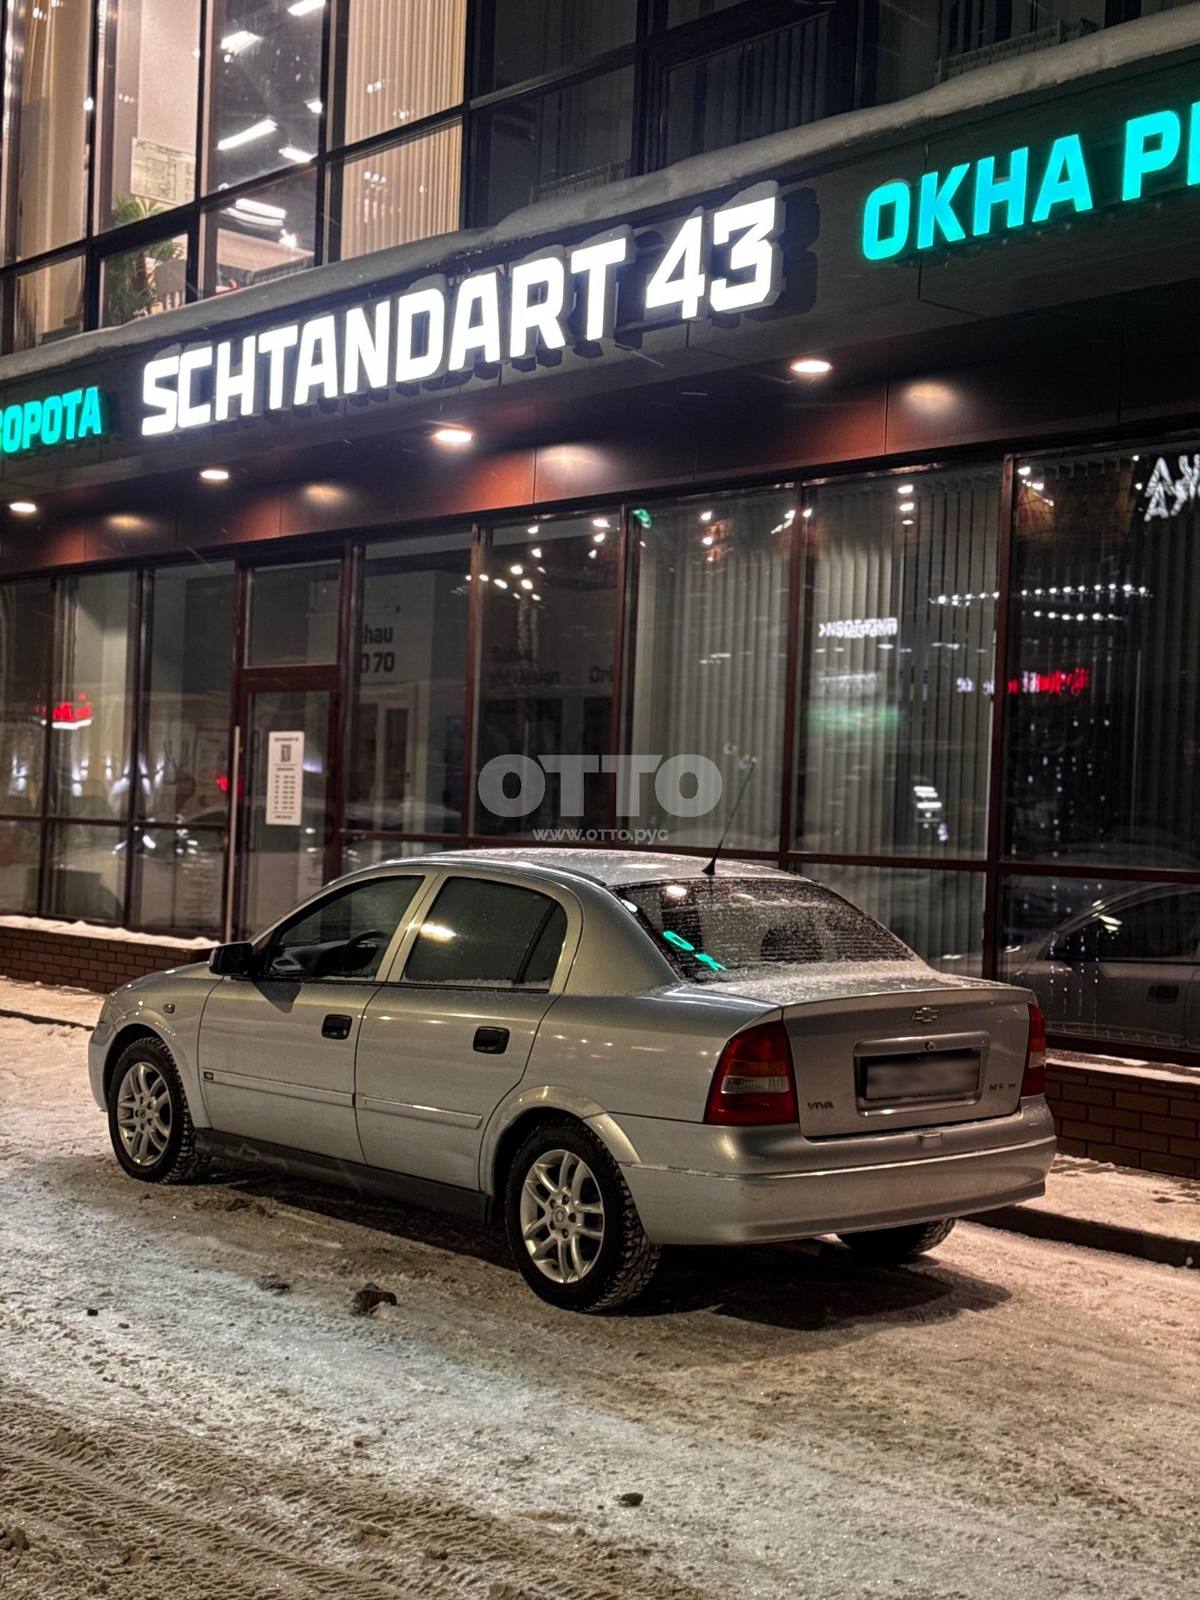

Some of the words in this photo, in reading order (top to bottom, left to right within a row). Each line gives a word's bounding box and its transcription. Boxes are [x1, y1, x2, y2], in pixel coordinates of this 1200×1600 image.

[862, 134, 1093, 261] ОКНА
[1122, 102, 1200, 202] Р
[142, 238, 626, 436] SCHTANDART
[645, 197, 776, 320] 43
[0, 386, 102, 453] ОРОТА
